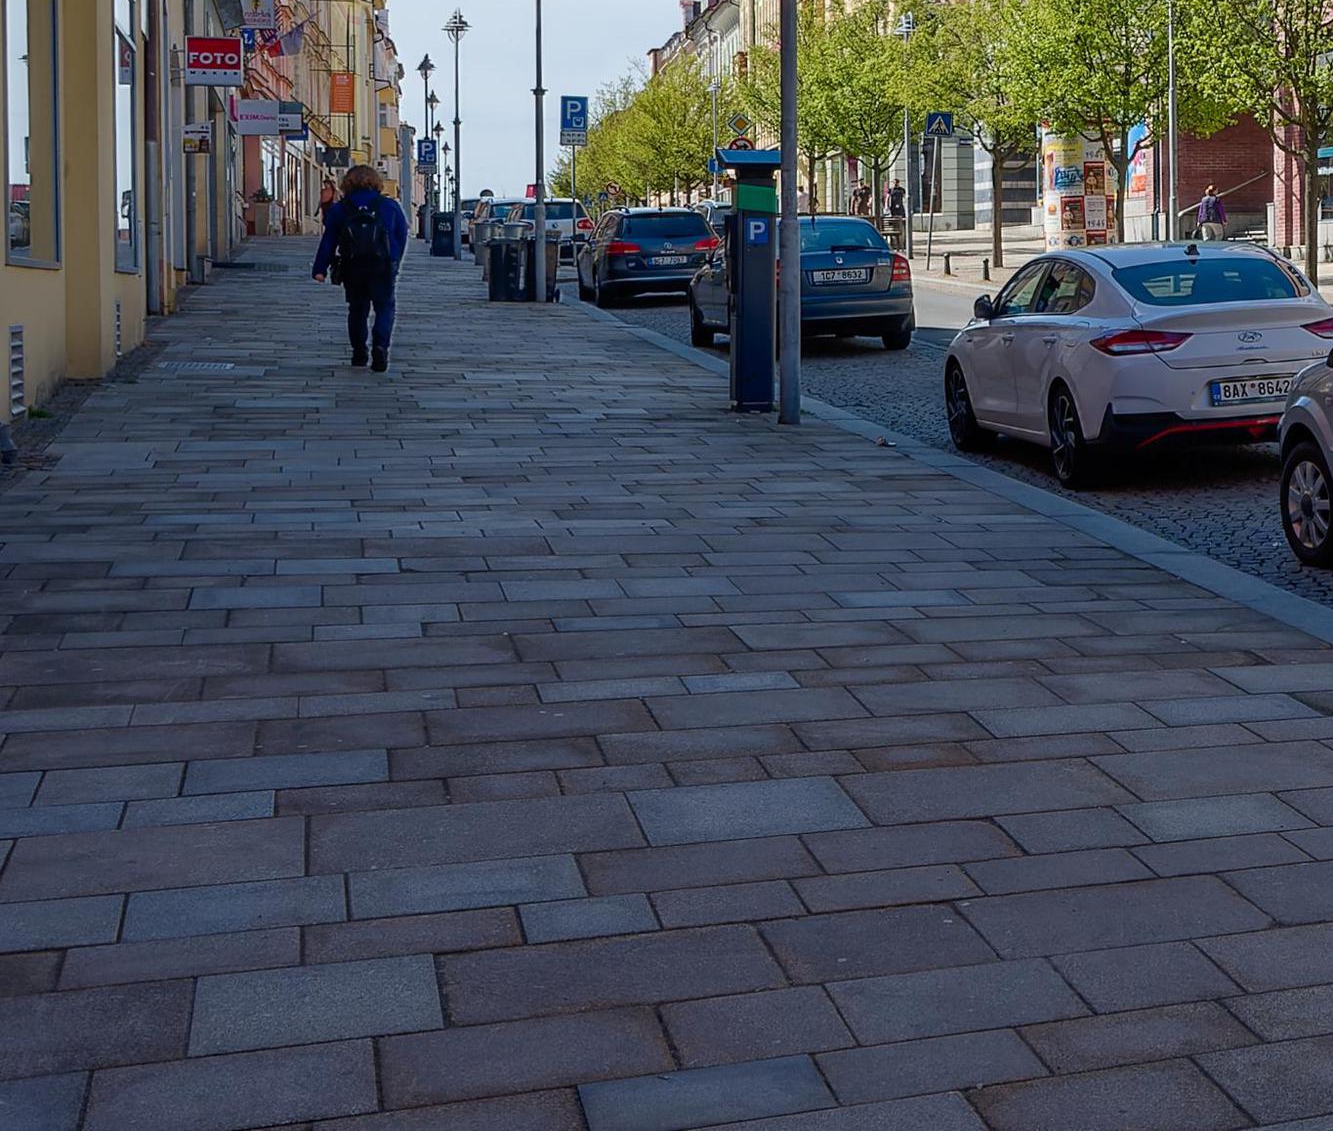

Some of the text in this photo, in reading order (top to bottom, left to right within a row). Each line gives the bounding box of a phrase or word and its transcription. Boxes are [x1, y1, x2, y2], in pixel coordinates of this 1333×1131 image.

[189, 52, 239, 65] FOTO
[566, 100, 582, 120] P
[750, 221, 766, 240] P
[1222, 380, 1291, 399] 8AX 8642
